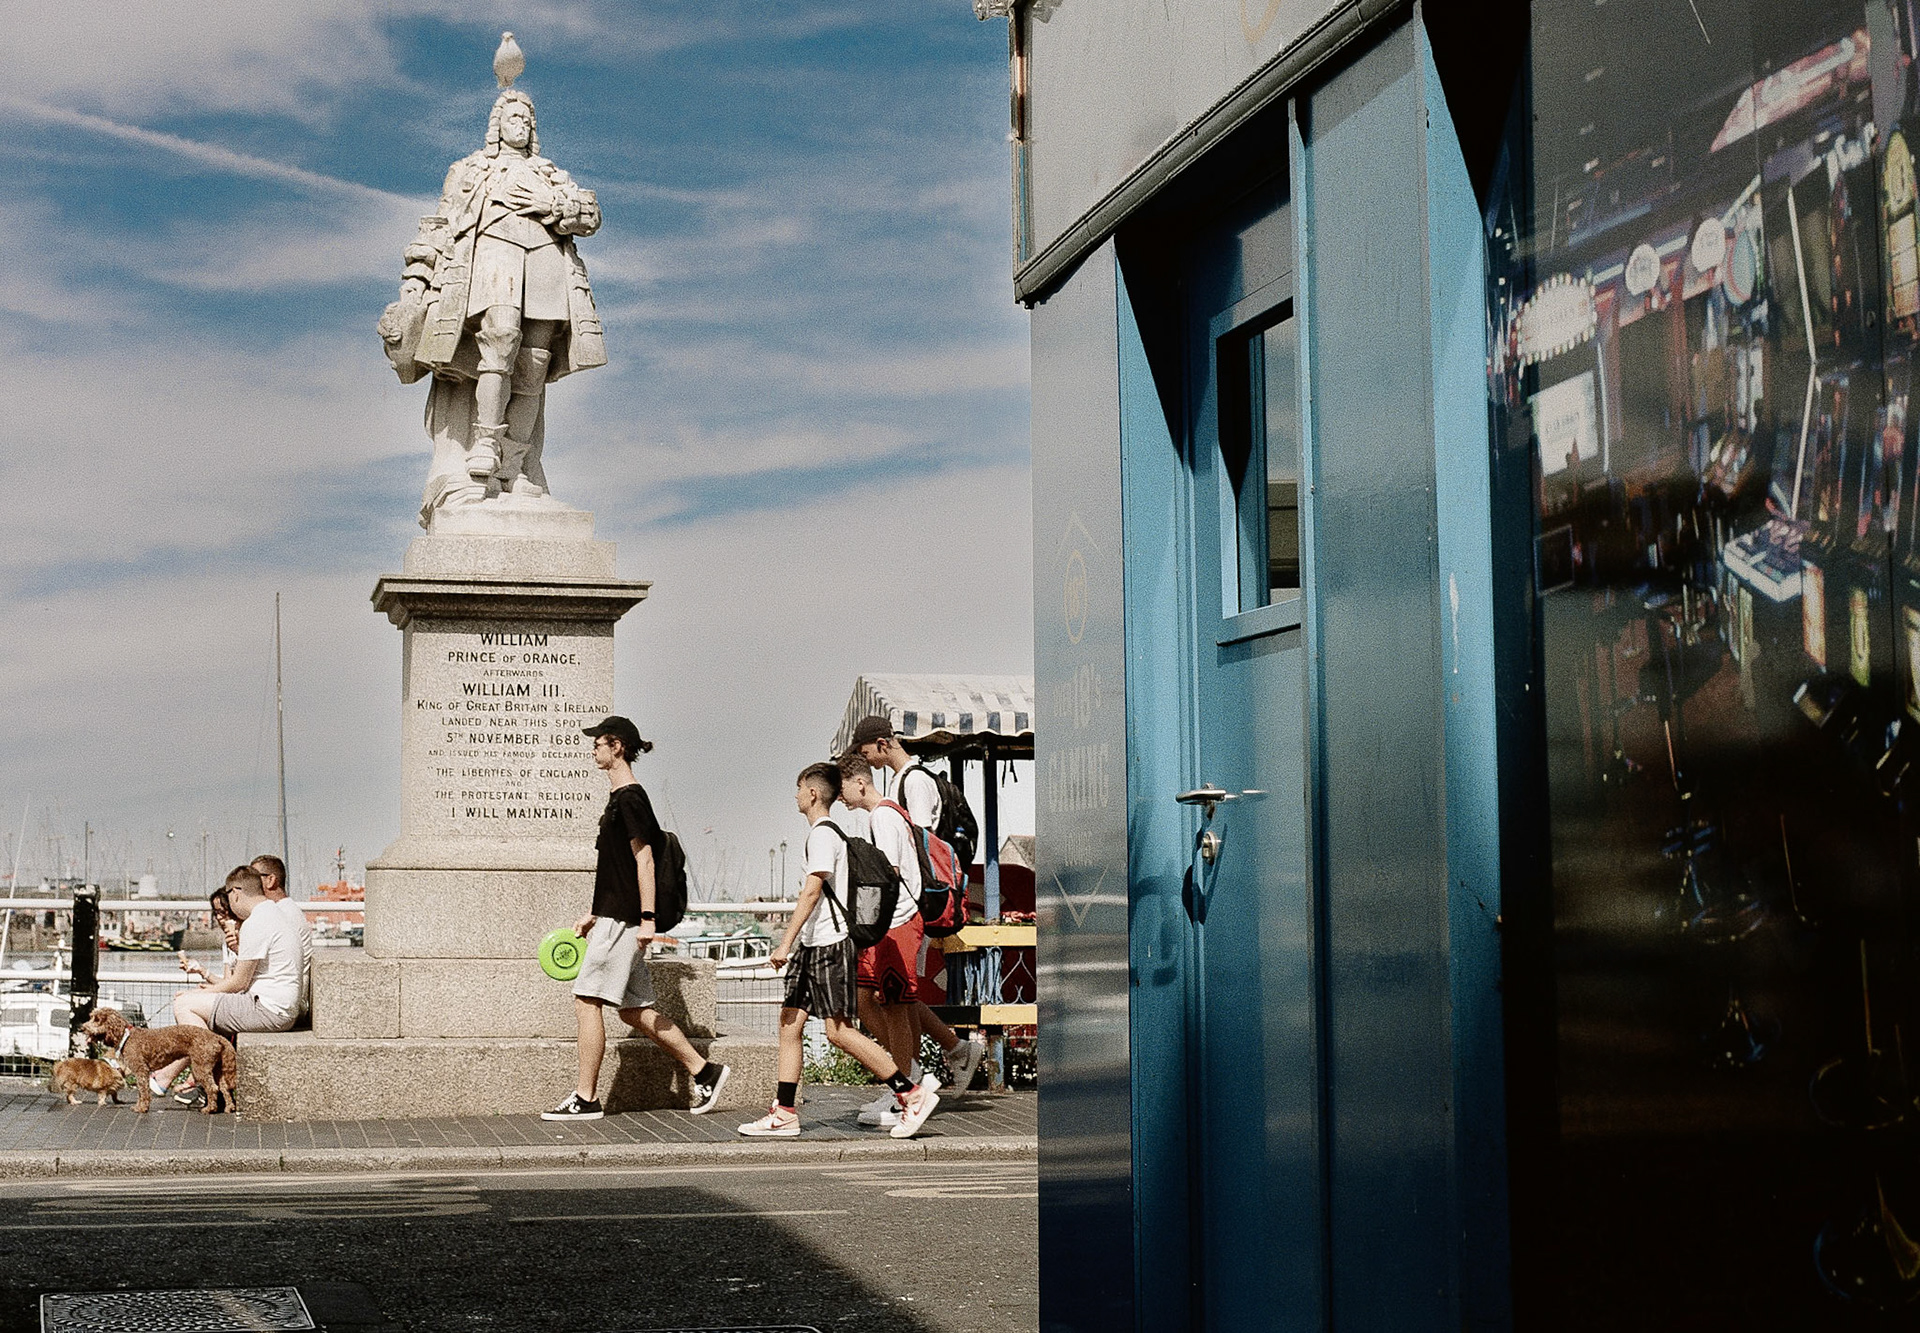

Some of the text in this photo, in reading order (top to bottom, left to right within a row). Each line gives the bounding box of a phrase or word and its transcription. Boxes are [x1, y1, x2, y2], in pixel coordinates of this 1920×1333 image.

[481, 633, 548, 646] WILLIAM
[448, 652, 496, 662] PRINCE
[463, 683, 565, 697] WILLIAM III.
[554, 704, 561, 712] &
[442, 718, 582, 728] LANDED NEAR THIS SPOT
[469, 734, 539, 744] NOVEMBER
[550, 735, 580, 745] 1688
[462, 768, 513, 777] LIBERTIES
[520, 769, 531, 777] OF
[540, 770, 589, 778] ENGLAND
[1048, 743, 1109, 813] GAMING
[435, 791, 591, 801] THE PROTESTANT RELIGION
[451, 807, 455, 818] I
[466, 808, 498, 818] WILL
